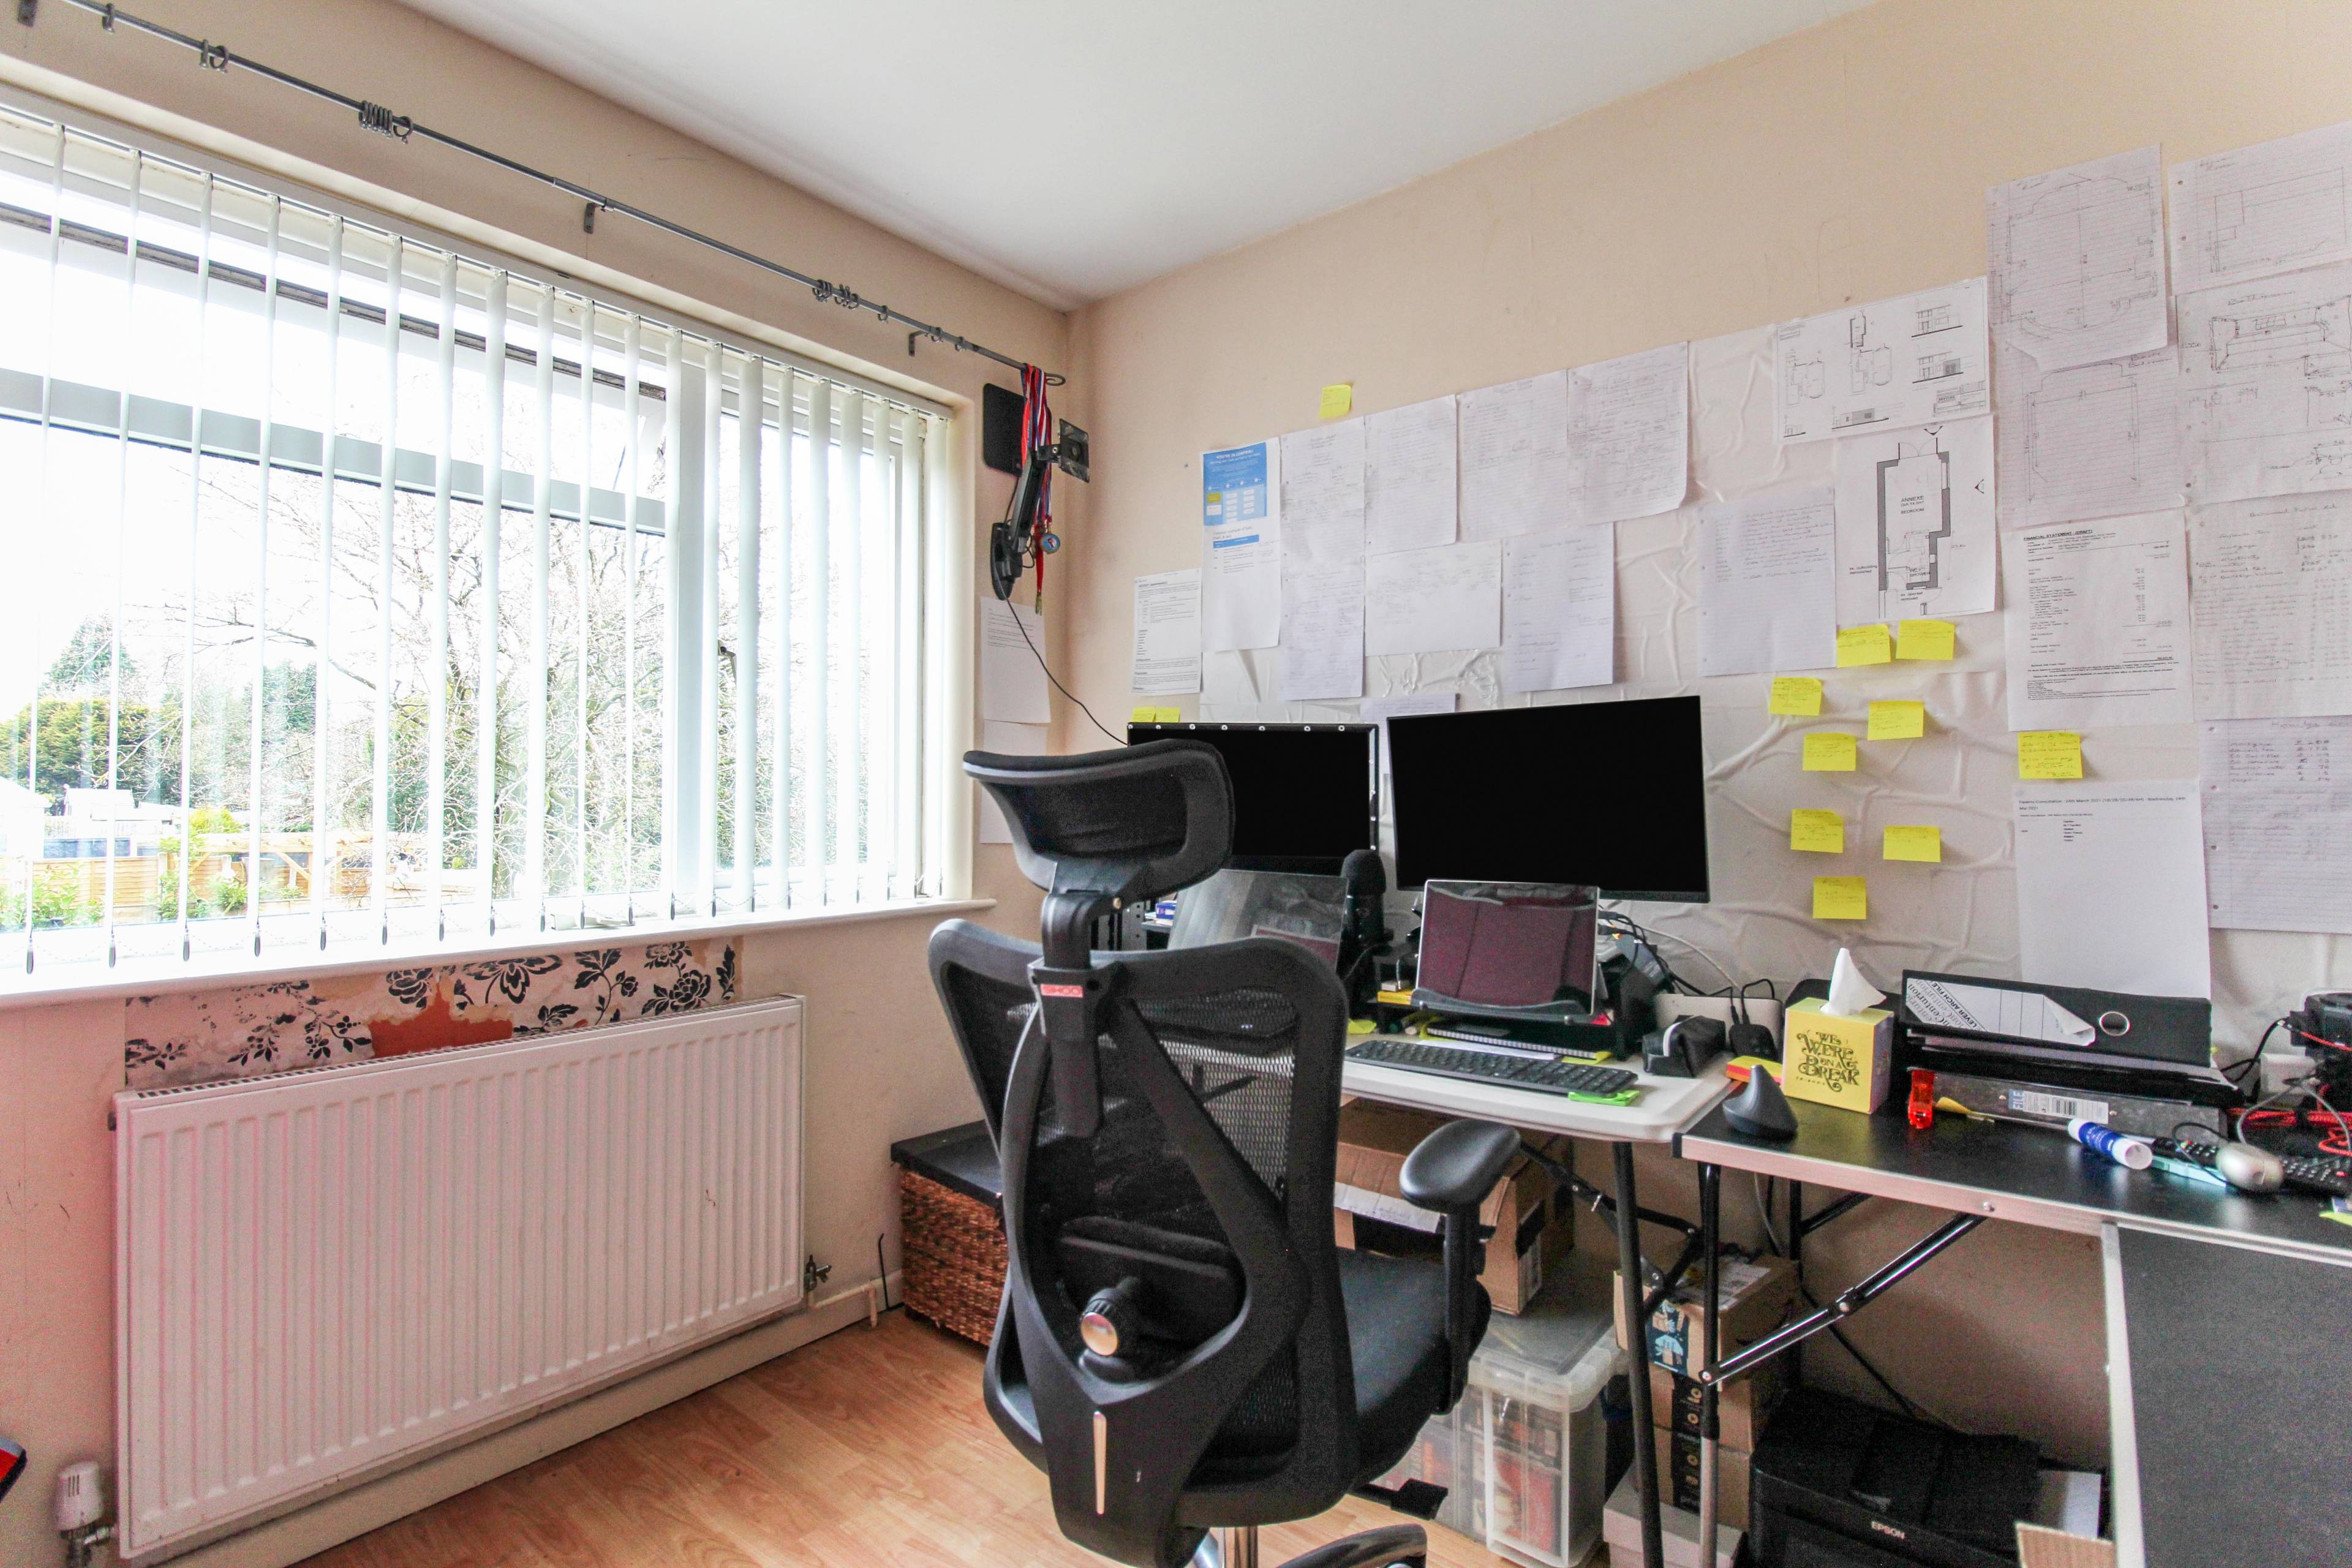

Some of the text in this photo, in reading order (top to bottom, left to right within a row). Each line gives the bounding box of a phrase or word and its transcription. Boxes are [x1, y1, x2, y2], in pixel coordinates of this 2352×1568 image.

[1932, 981, 1977, 1028] LEVER ARCH FILE
[1815, 1032, 1842, 1045] WE
[1796, 1033, 1855, 1066] WERE
[1819, 1057, 1834, 1066] ON
[1798, 1054, 1860, 1090] BREAK
[2013, 1090, 2025, 1110] FILE
[1871, 1521, 1905, 1539] EPSON
